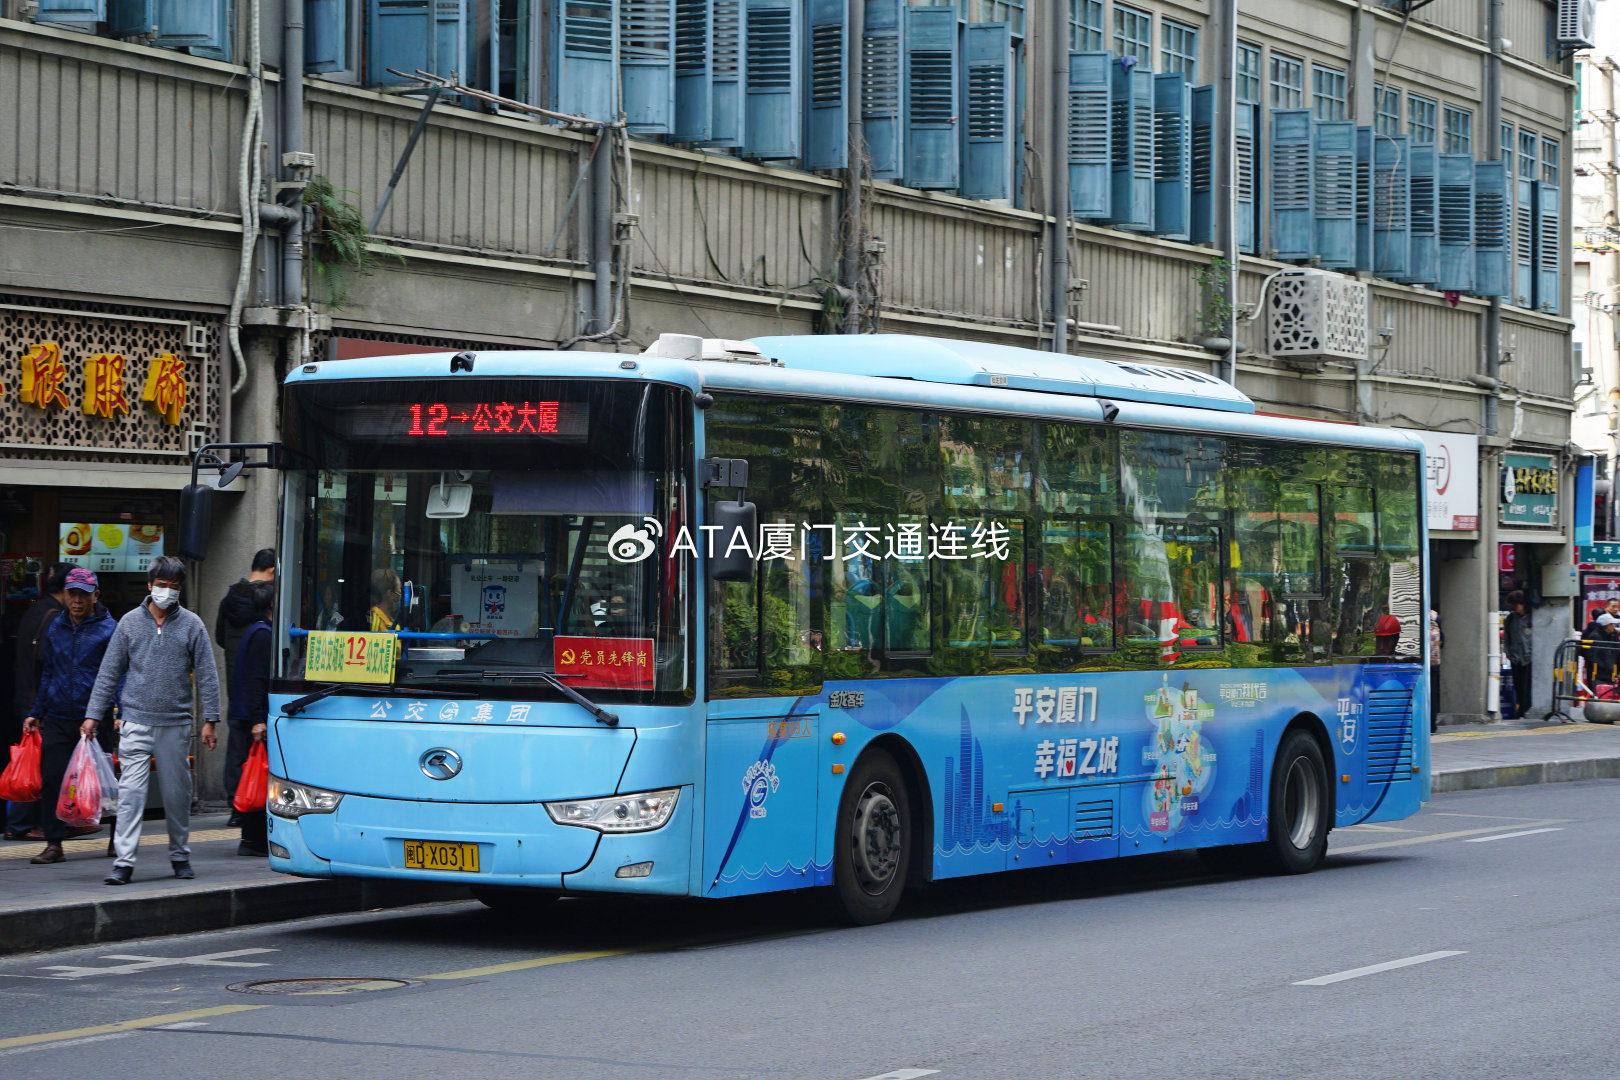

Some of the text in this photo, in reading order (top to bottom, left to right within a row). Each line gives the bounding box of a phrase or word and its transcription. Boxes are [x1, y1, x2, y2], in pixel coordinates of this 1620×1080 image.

[0, 342, 187, 426] 欣服饰
[408, 401, 559, 436] 12 公交大厦
[347, 636, 367, 660] 12
[366, 638, 391, 675] 公交大厦
[580, 649, 647, 668] 党员先锋岗
[829, 690, 865, 709] 金龙客车
[1012, 686, 1098, 726] 平安厦门
[768, 719, 811, 738] 核载89人
[1336, 697, 1357, 743] 平安
[1034, 735, 1120, 778] 幸福之城
[268, 817, 274, 834] 9
